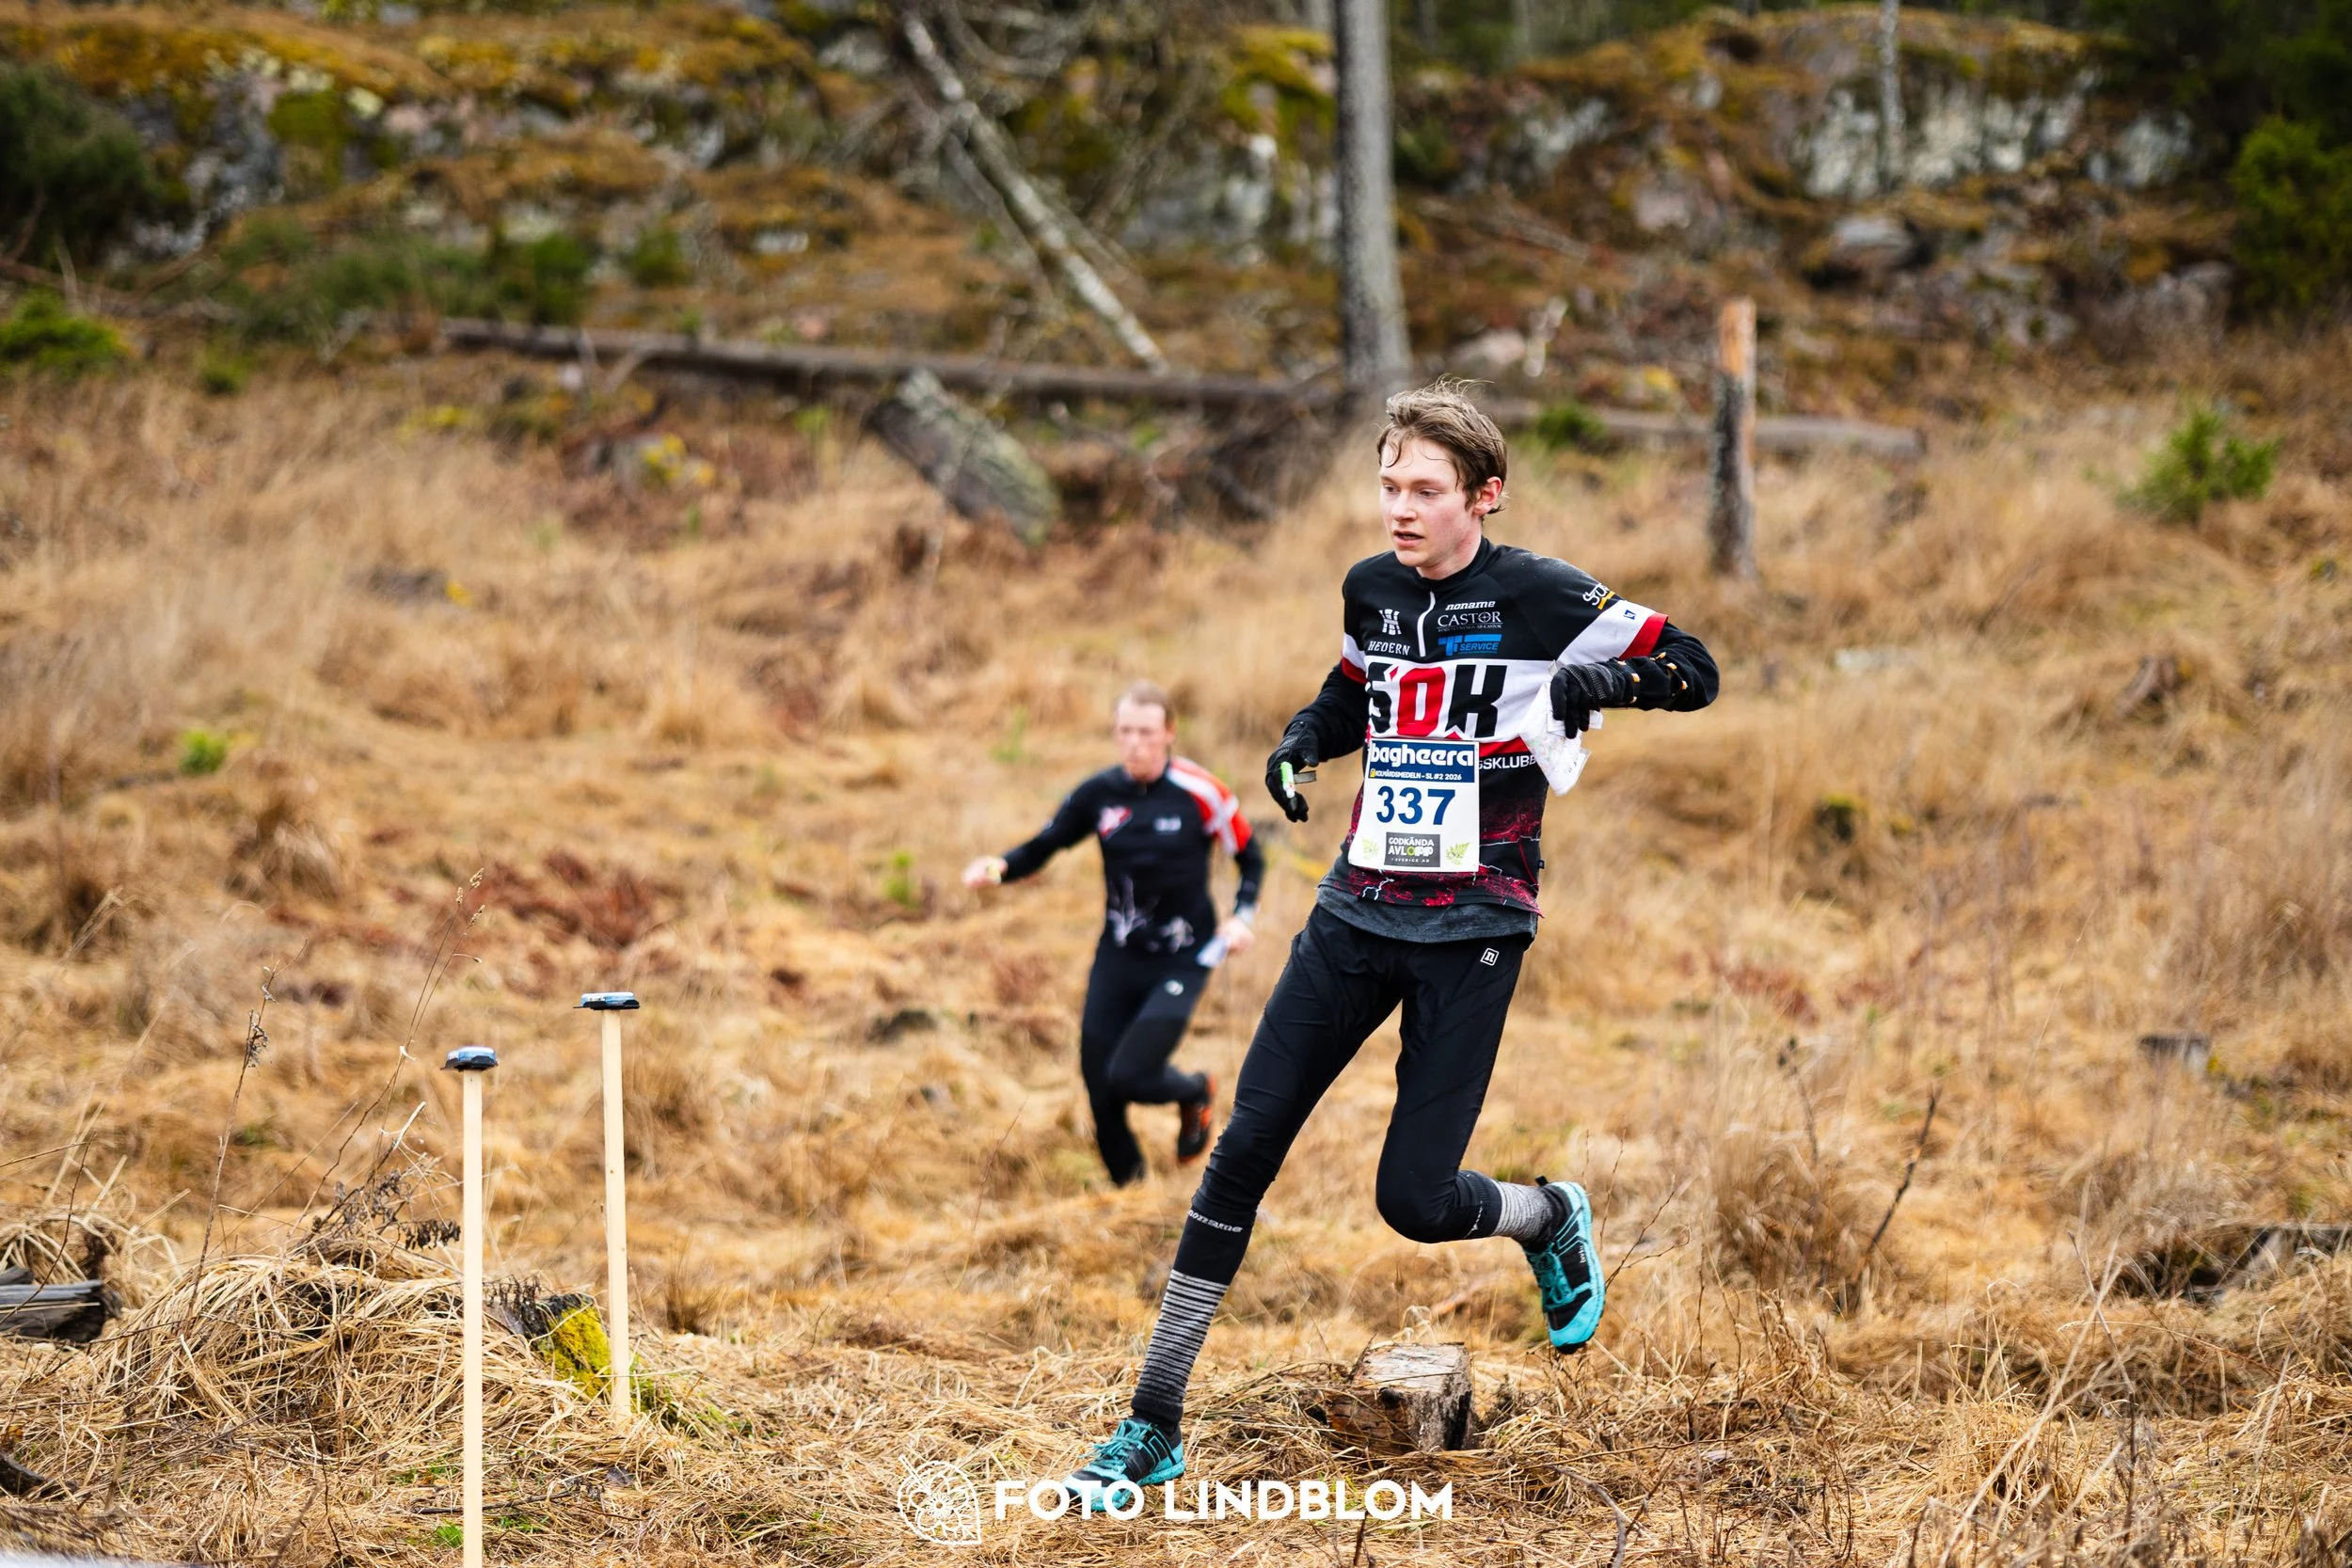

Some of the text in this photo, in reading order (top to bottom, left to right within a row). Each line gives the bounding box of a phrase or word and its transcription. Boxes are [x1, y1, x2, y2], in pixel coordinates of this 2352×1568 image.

[1445, 601, 1496, 610] noname
[1438, 611, 1502, 626] CASTOR
[1460, 642, 1500, 651] SERVICE
[1365, 661, 1508, 738] SOK
[1370, 743, 1474, 768] bagheera
[1375, 785, 1455, 825] 337
